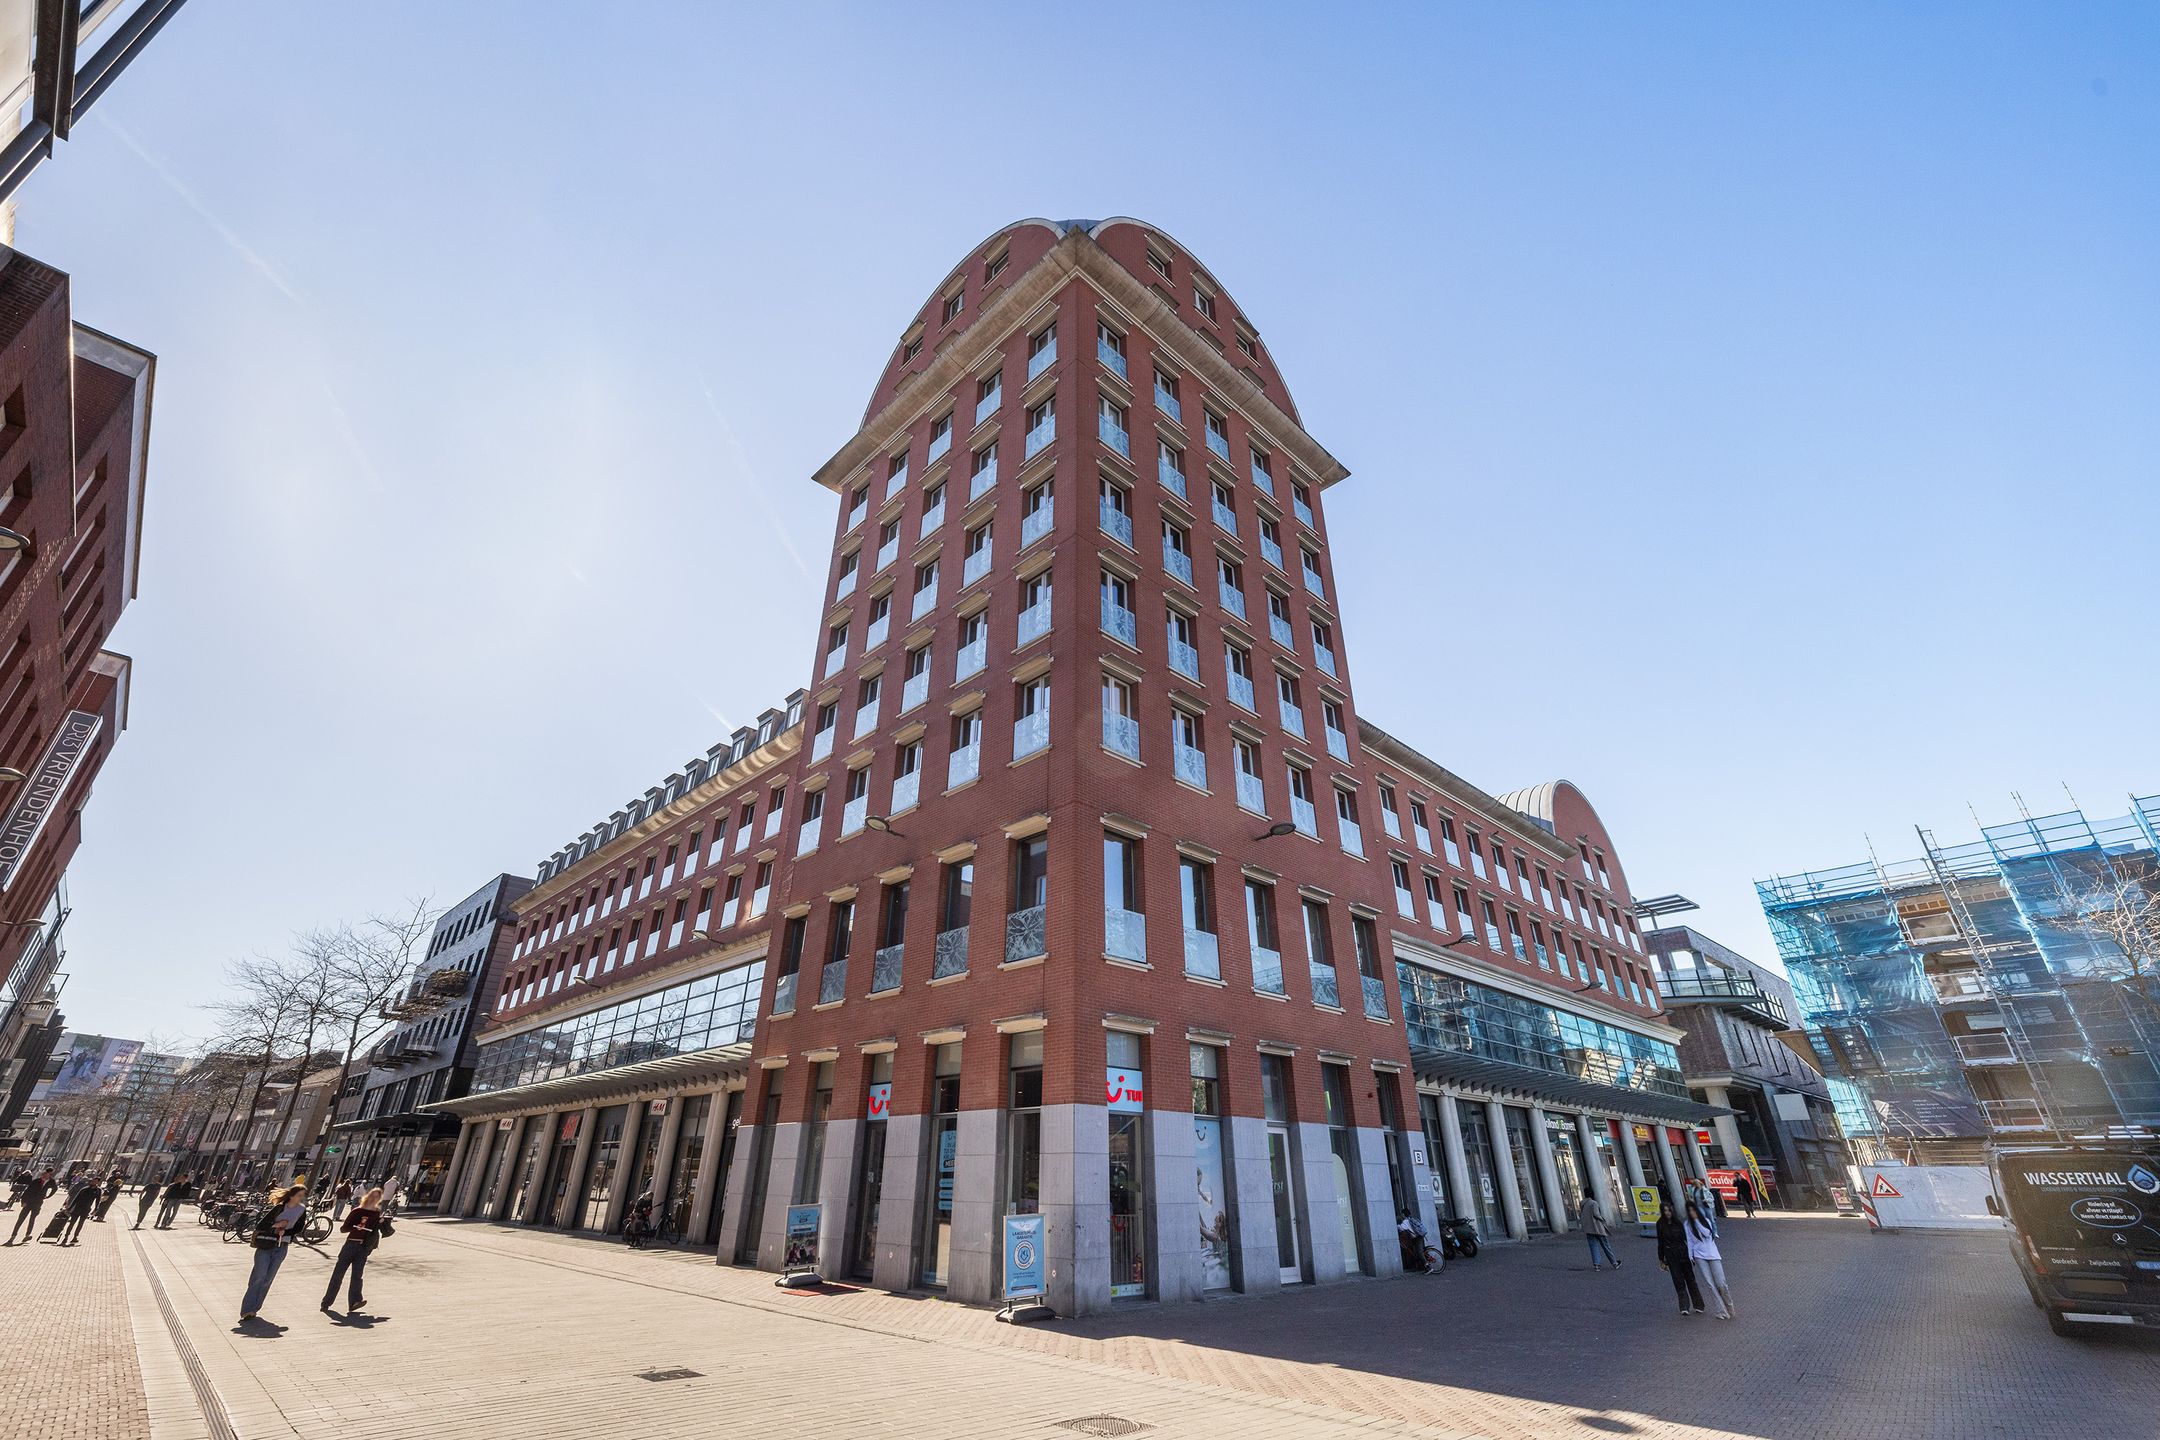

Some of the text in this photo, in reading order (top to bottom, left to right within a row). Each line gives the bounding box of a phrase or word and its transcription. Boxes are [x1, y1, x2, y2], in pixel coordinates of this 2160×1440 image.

[1709, 1175, 1734, 1185] Kruidv
[2024, 1172, 2126, 1186] WASSERTHAL
[2051, 1257, 2078, 1265] Dordrecht
